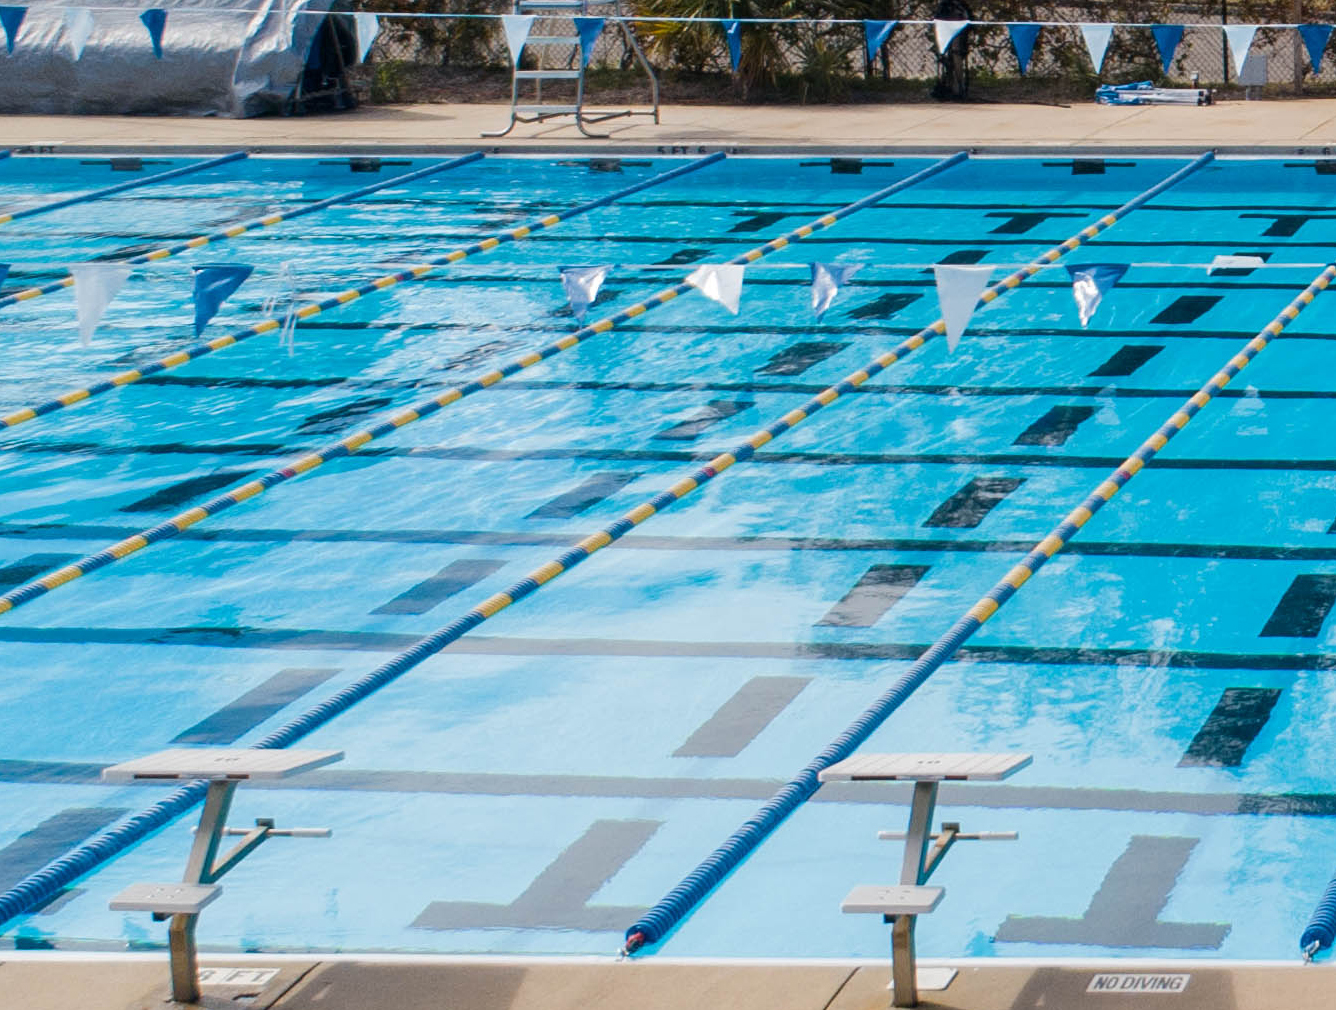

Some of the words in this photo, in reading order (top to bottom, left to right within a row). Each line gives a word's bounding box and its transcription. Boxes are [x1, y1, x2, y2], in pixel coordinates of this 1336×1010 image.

[671, 146, 688, 155] FT
[1093, 976, 1119, 989] NO
[1120, 976, 1183, 990] DIVING
